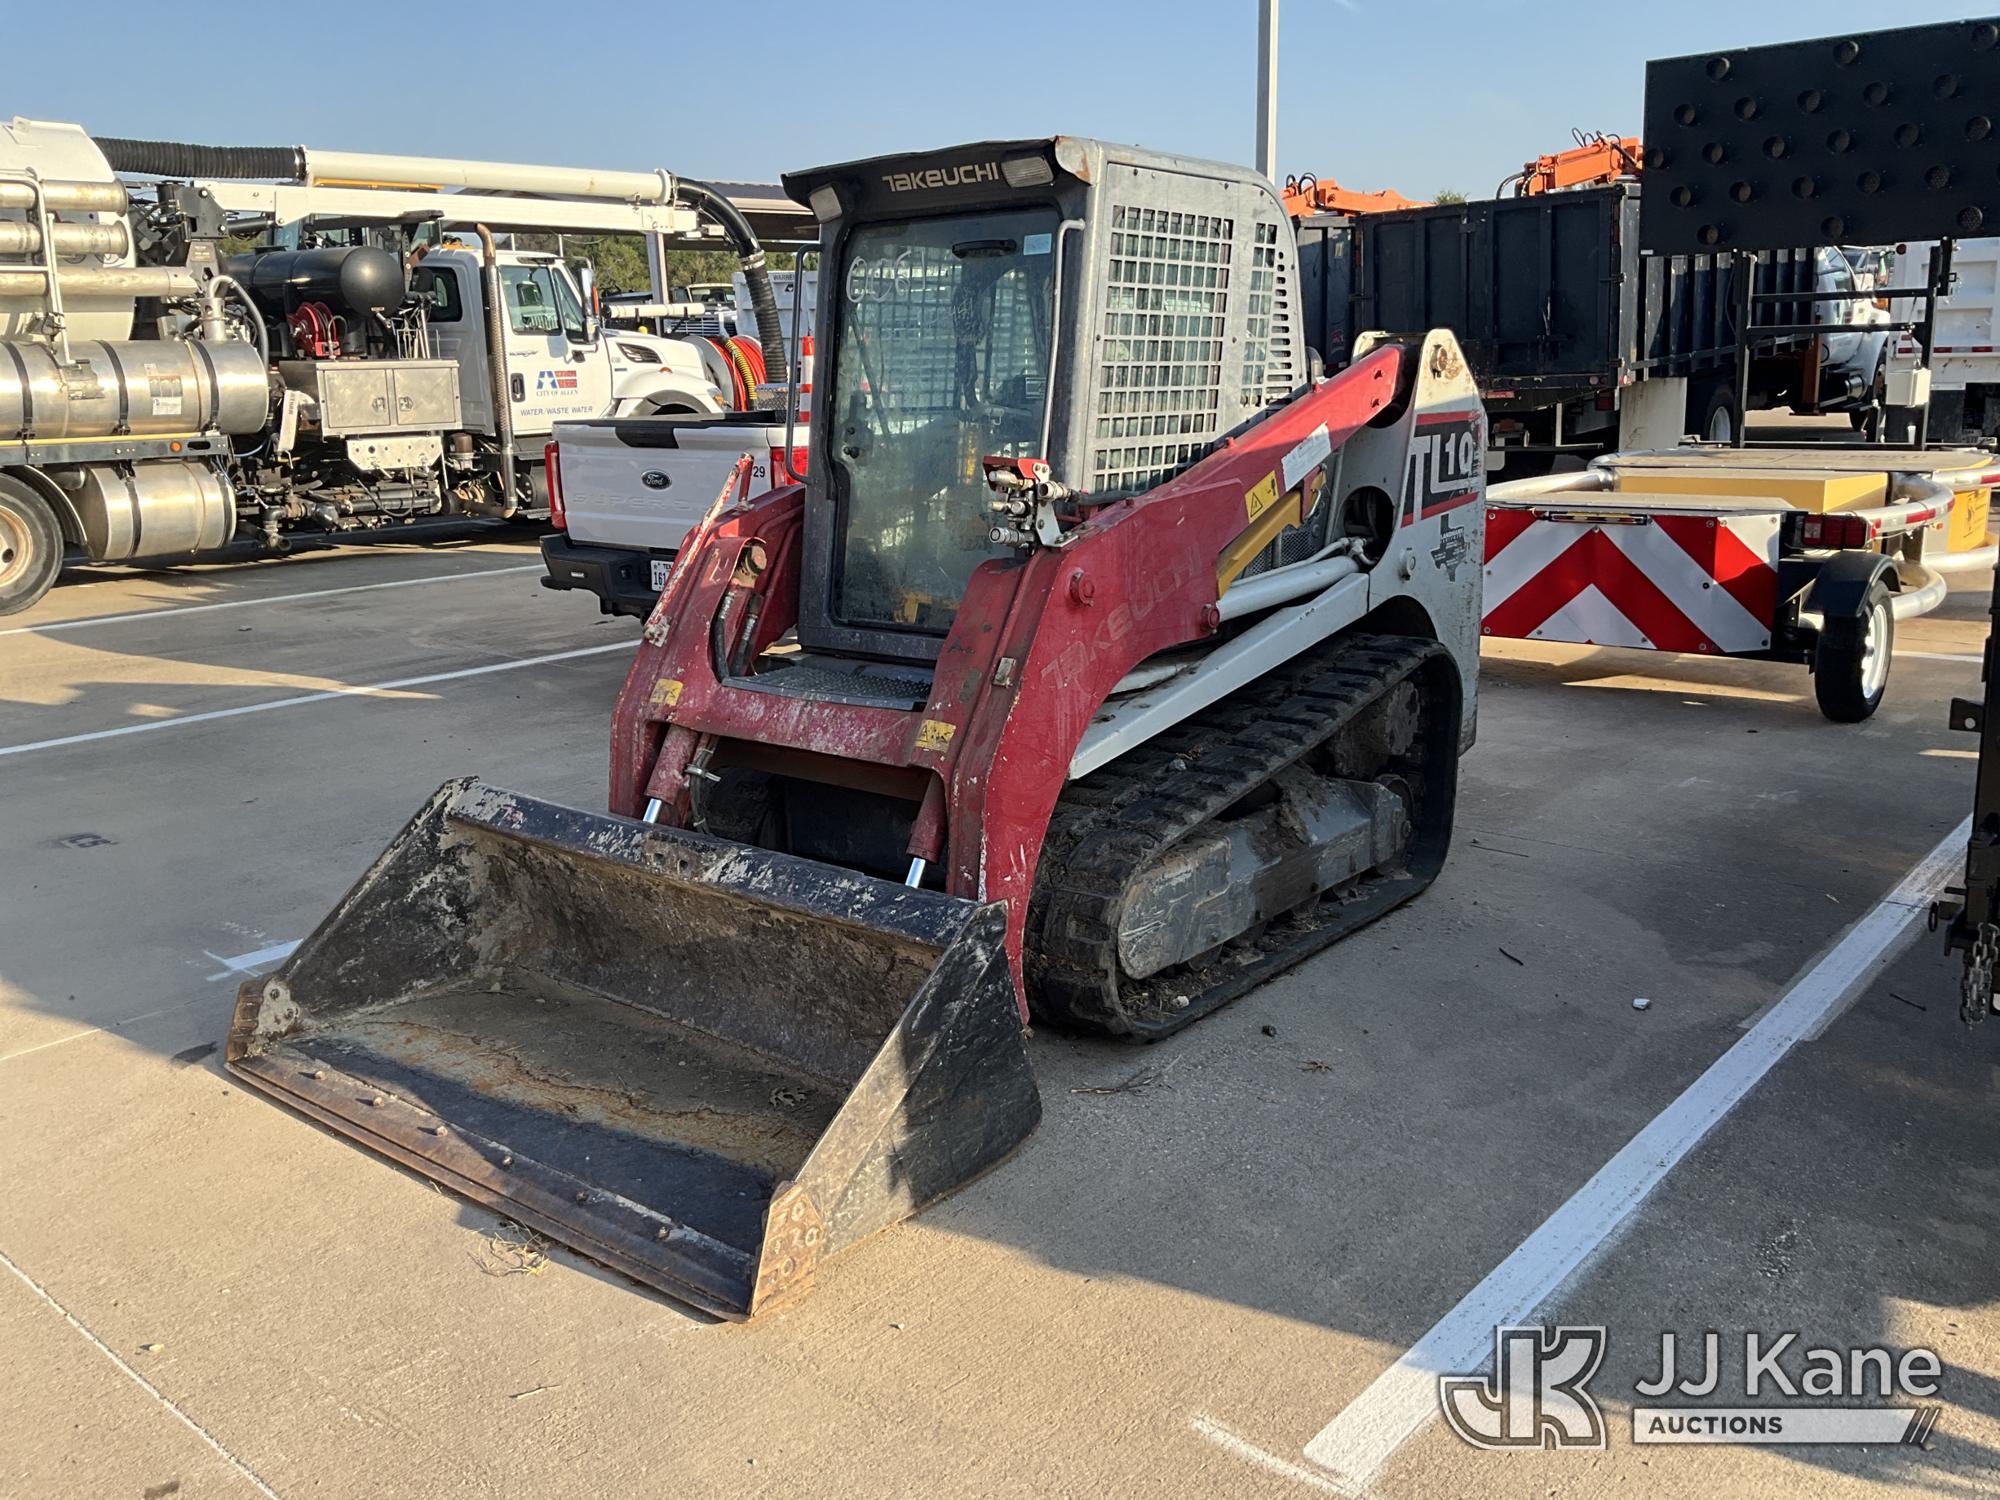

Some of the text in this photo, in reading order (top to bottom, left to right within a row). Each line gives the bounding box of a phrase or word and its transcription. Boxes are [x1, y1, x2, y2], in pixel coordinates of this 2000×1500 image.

[882, 161, 999, 192] TAKEUCHI
[561, 388, 579, 396] ALLEN
[572, 405, 593, 414] WATER
